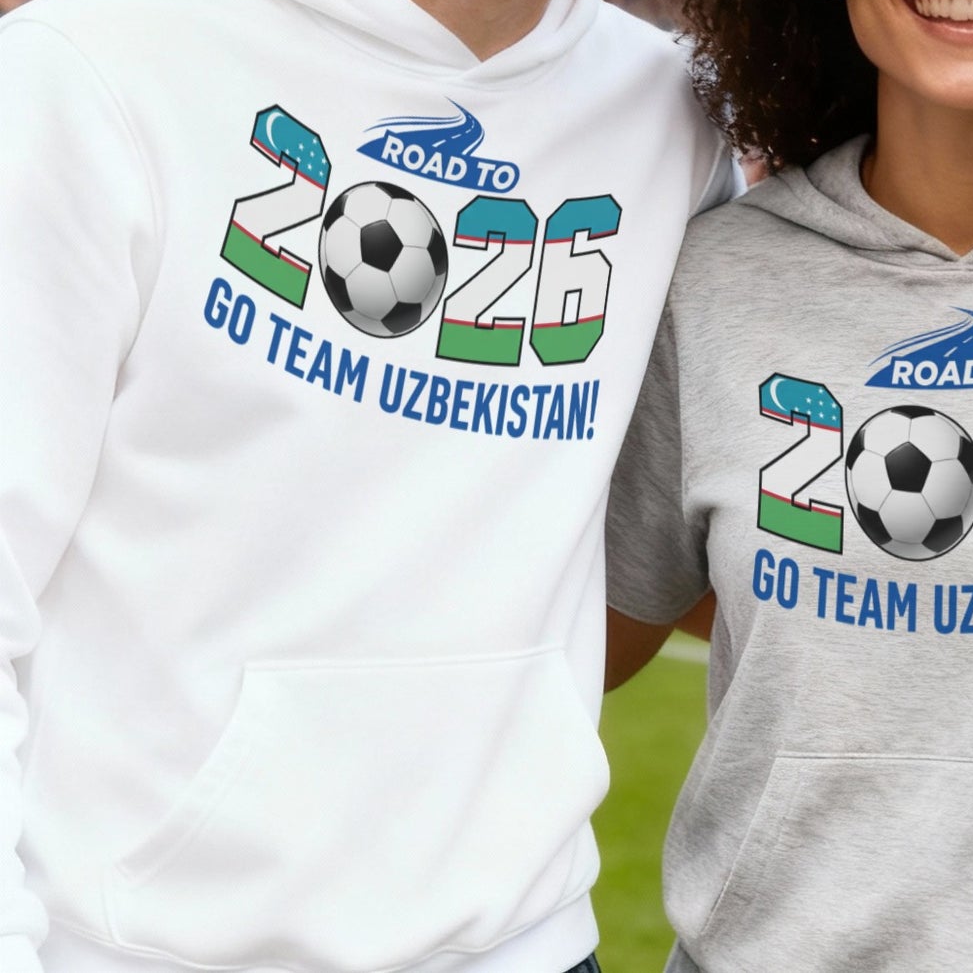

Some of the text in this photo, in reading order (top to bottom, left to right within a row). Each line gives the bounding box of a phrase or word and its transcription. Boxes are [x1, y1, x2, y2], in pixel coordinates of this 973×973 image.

[381, 134, 517, 189] ROAD TO
[203, 277, 600, 441] GO TEAM UZBEKISTAN!
[752, 548, 800, 610] GO
[812, 566, 918, 633] TEAM
